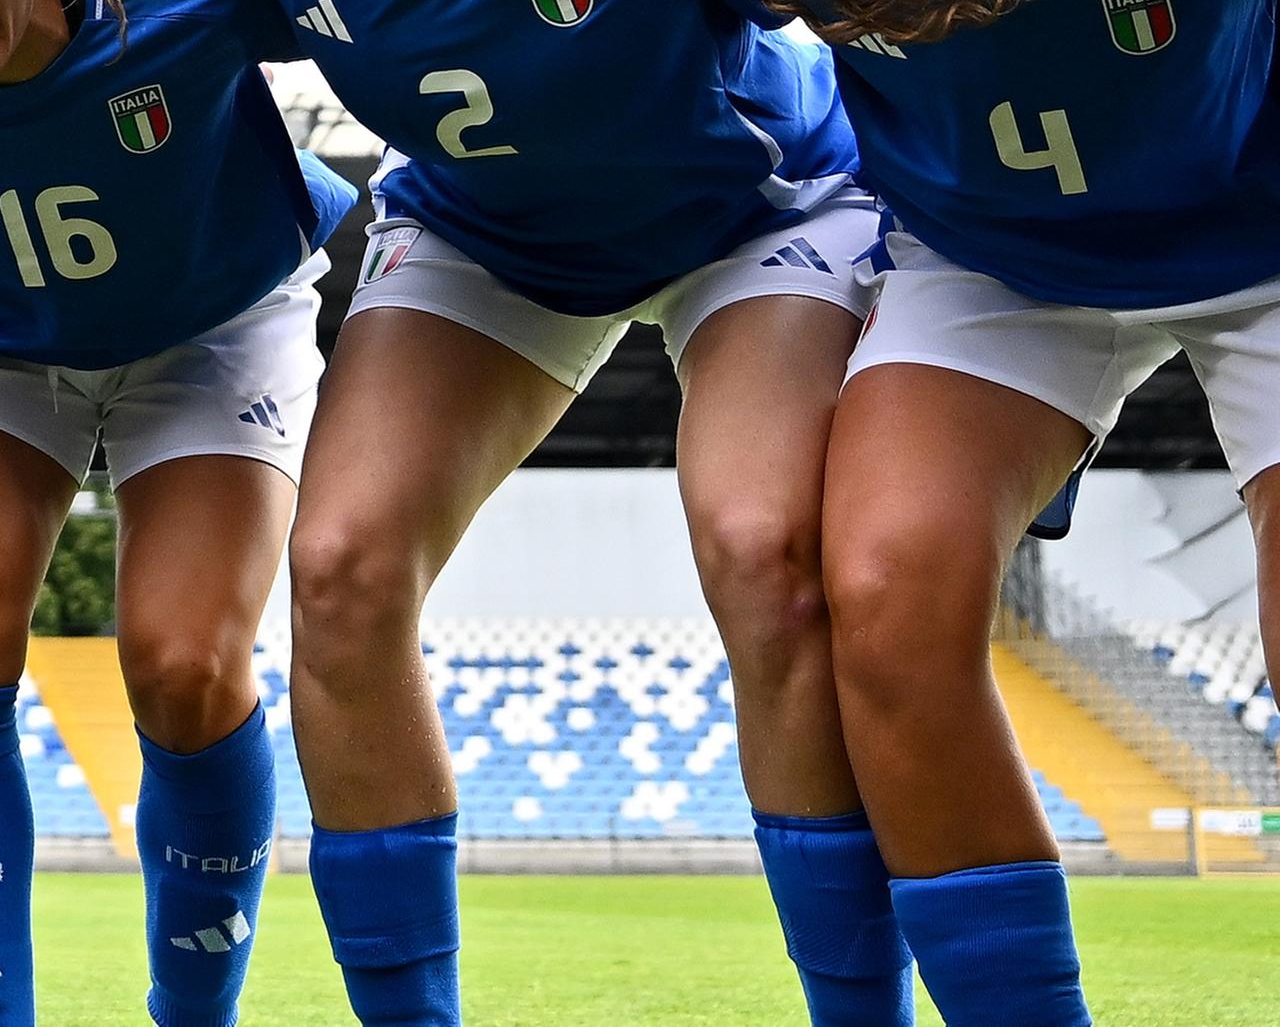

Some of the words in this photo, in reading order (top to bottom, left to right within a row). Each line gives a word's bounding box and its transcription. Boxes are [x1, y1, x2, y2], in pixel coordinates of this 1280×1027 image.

[113, 90, 160, 113] ITALIA
[419, 68, 518, 159] 2
[988, 101, 1088, 195] 4
